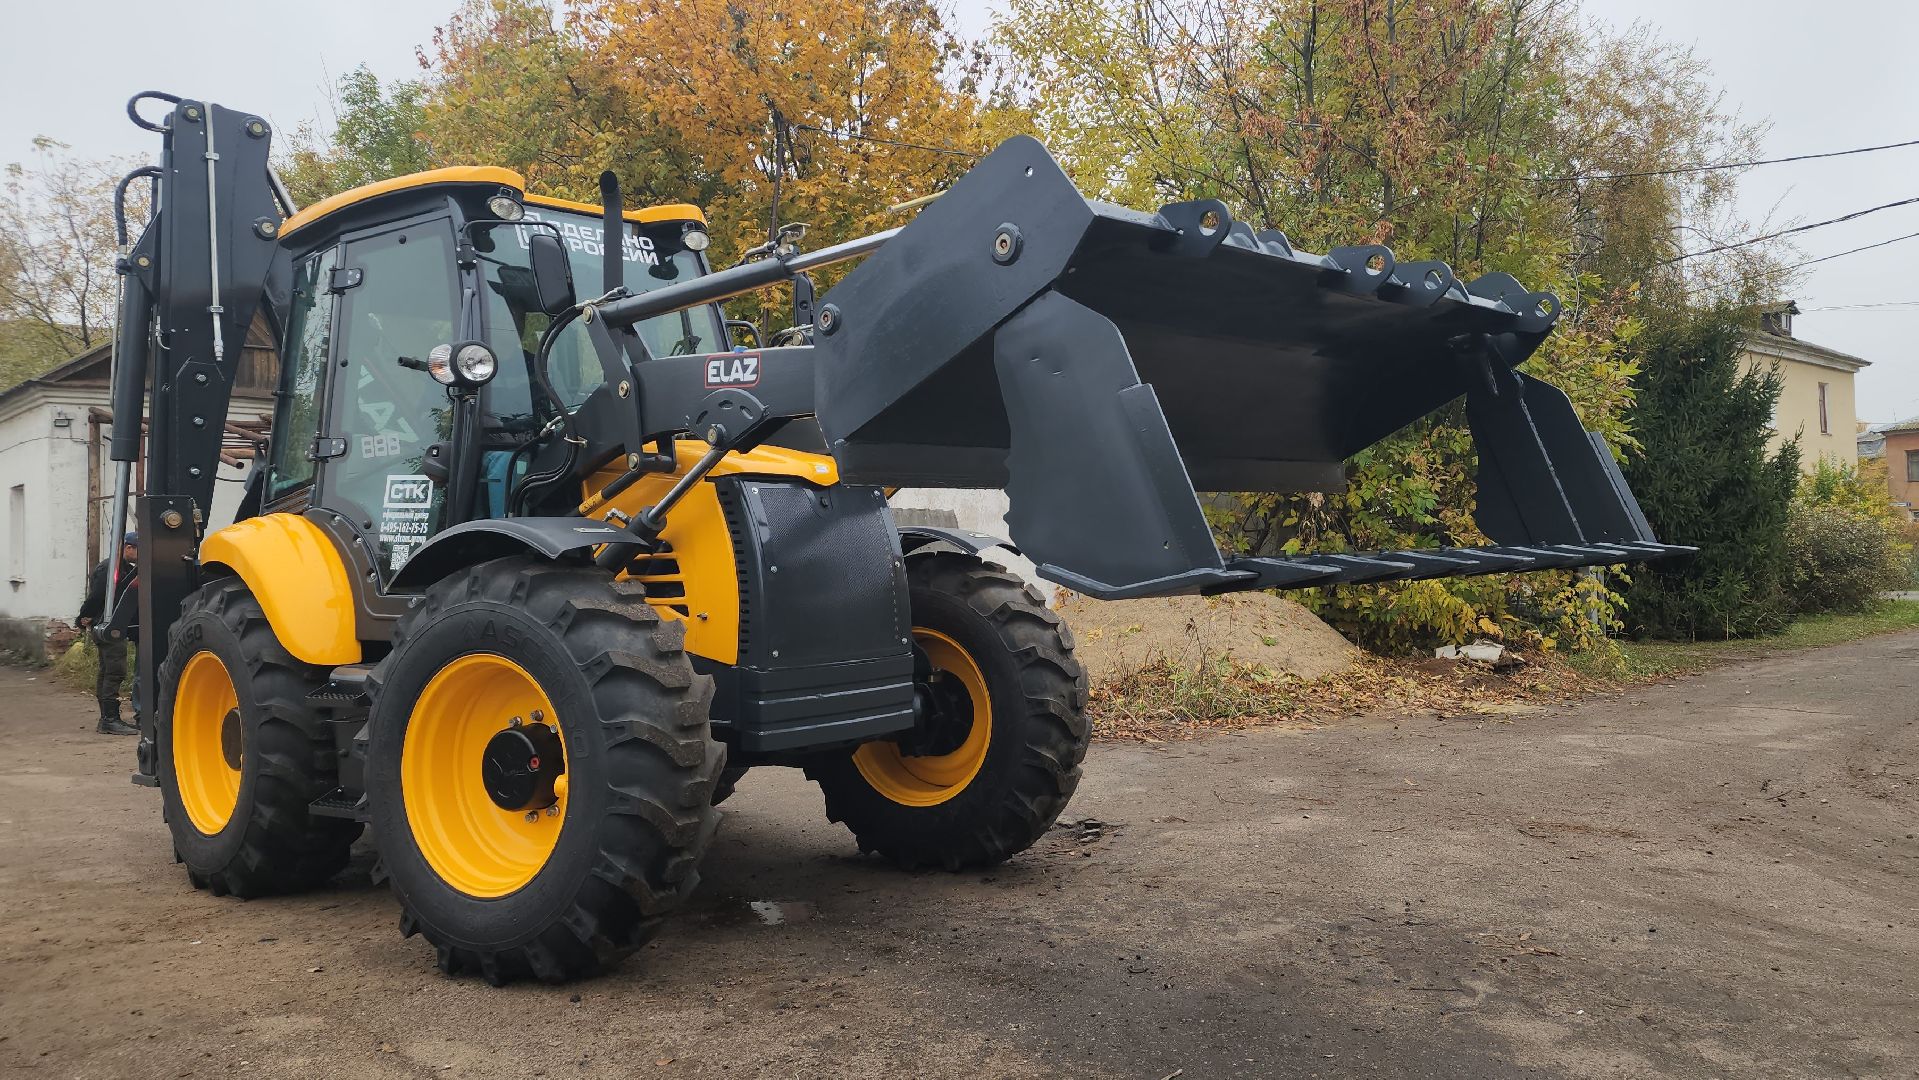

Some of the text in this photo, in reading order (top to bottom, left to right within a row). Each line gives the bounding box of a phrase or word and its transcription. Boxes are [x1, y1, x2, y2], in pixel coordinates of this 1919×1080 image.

[547, 219, 655, 250] СДЕЛНО
[707, 357, 758, 383] ELAZ
[390, 483, 428, 500] СТК
